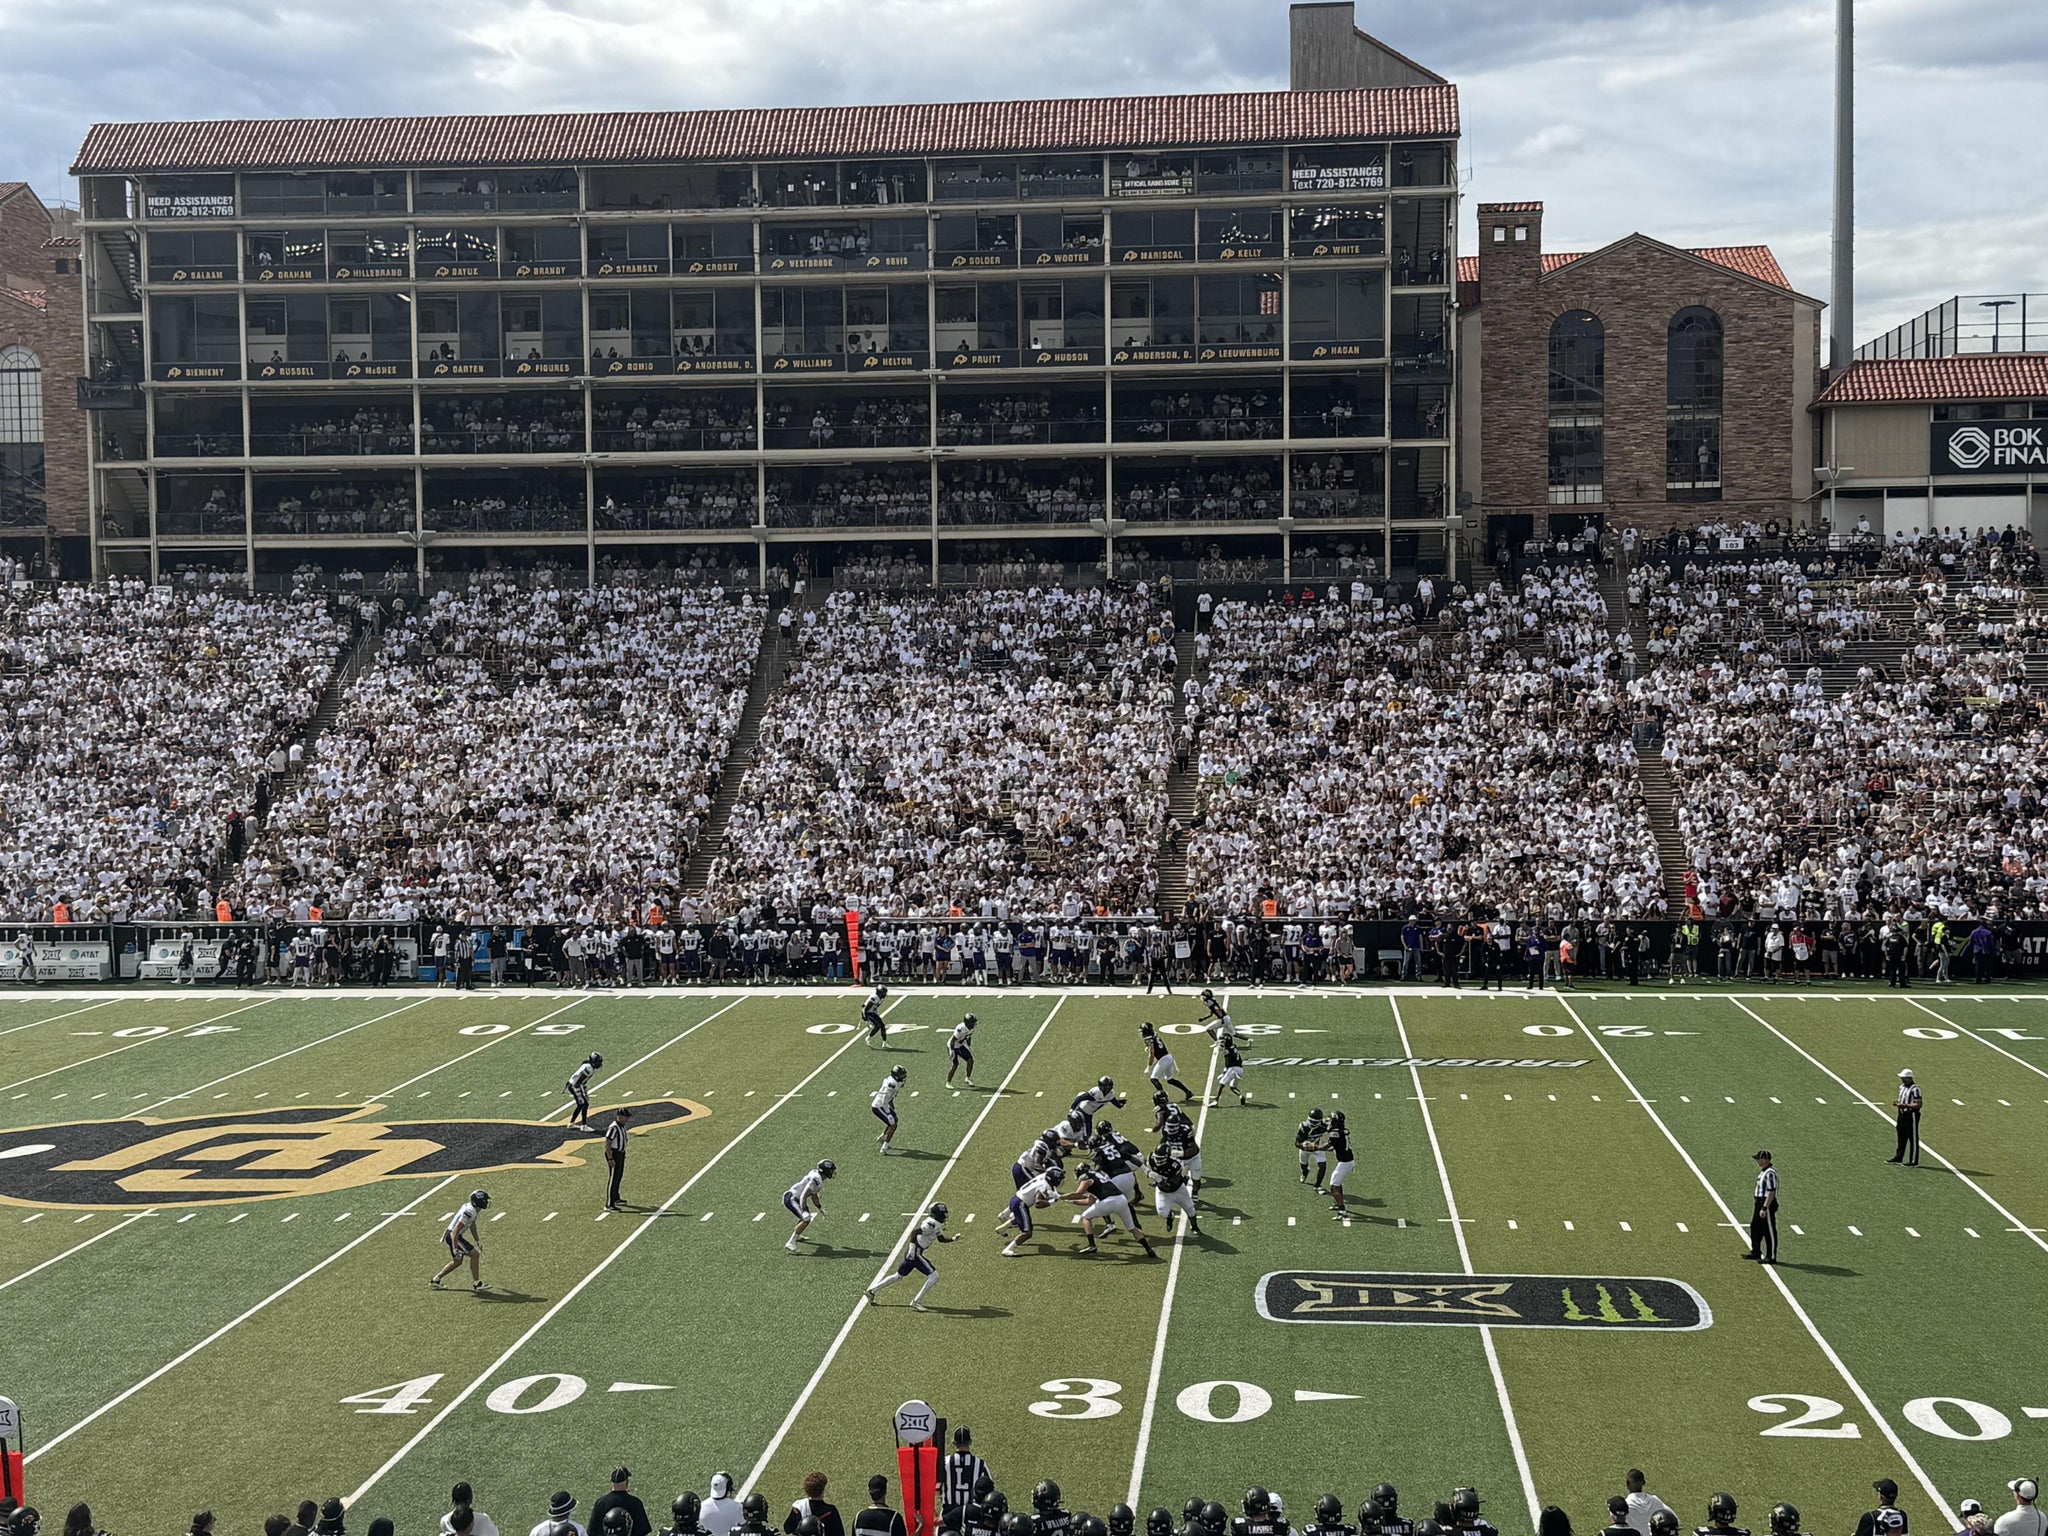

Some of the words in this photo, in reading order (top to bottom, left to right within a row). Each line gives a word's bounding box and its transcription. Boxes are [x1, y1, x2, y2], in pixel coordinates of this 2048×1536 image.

[1292, 168, 1316, 178] NEED
[1320, 167, 1384, 178] ASSISTANCE?
[1292, 180, 1312, 190] Text
[1316, 178, 1383, 189] 720-812-1769
[148, 197, 170, 206] NEED
[174, 196, 233, 205] ASSISTANCE?
[148, 207, 168, 216] Text
[170, 206, 233, 216] 720-812-1769
[1238, 249, 1262, 258] KELLY
[1332, 246, 1360, 254] WHITE
[792, 359, 833, 368] WILLIAMS
[1994, 427, 2042, 446] BOK
[1522, 1024, 1655, 1038] 20
[1242, 1057, 1592, 1068] PROGRESSIVE
[1103, 1144, 1121, 1160] 55
[338, 1373, 588, 1414] 40
[1028, 1378, 1272, 1422] 30
[900, 1412, 930, 1431] XII
[1747, 1394, 2012, 1441] 20
[955, 1467, 968, 1490] L
